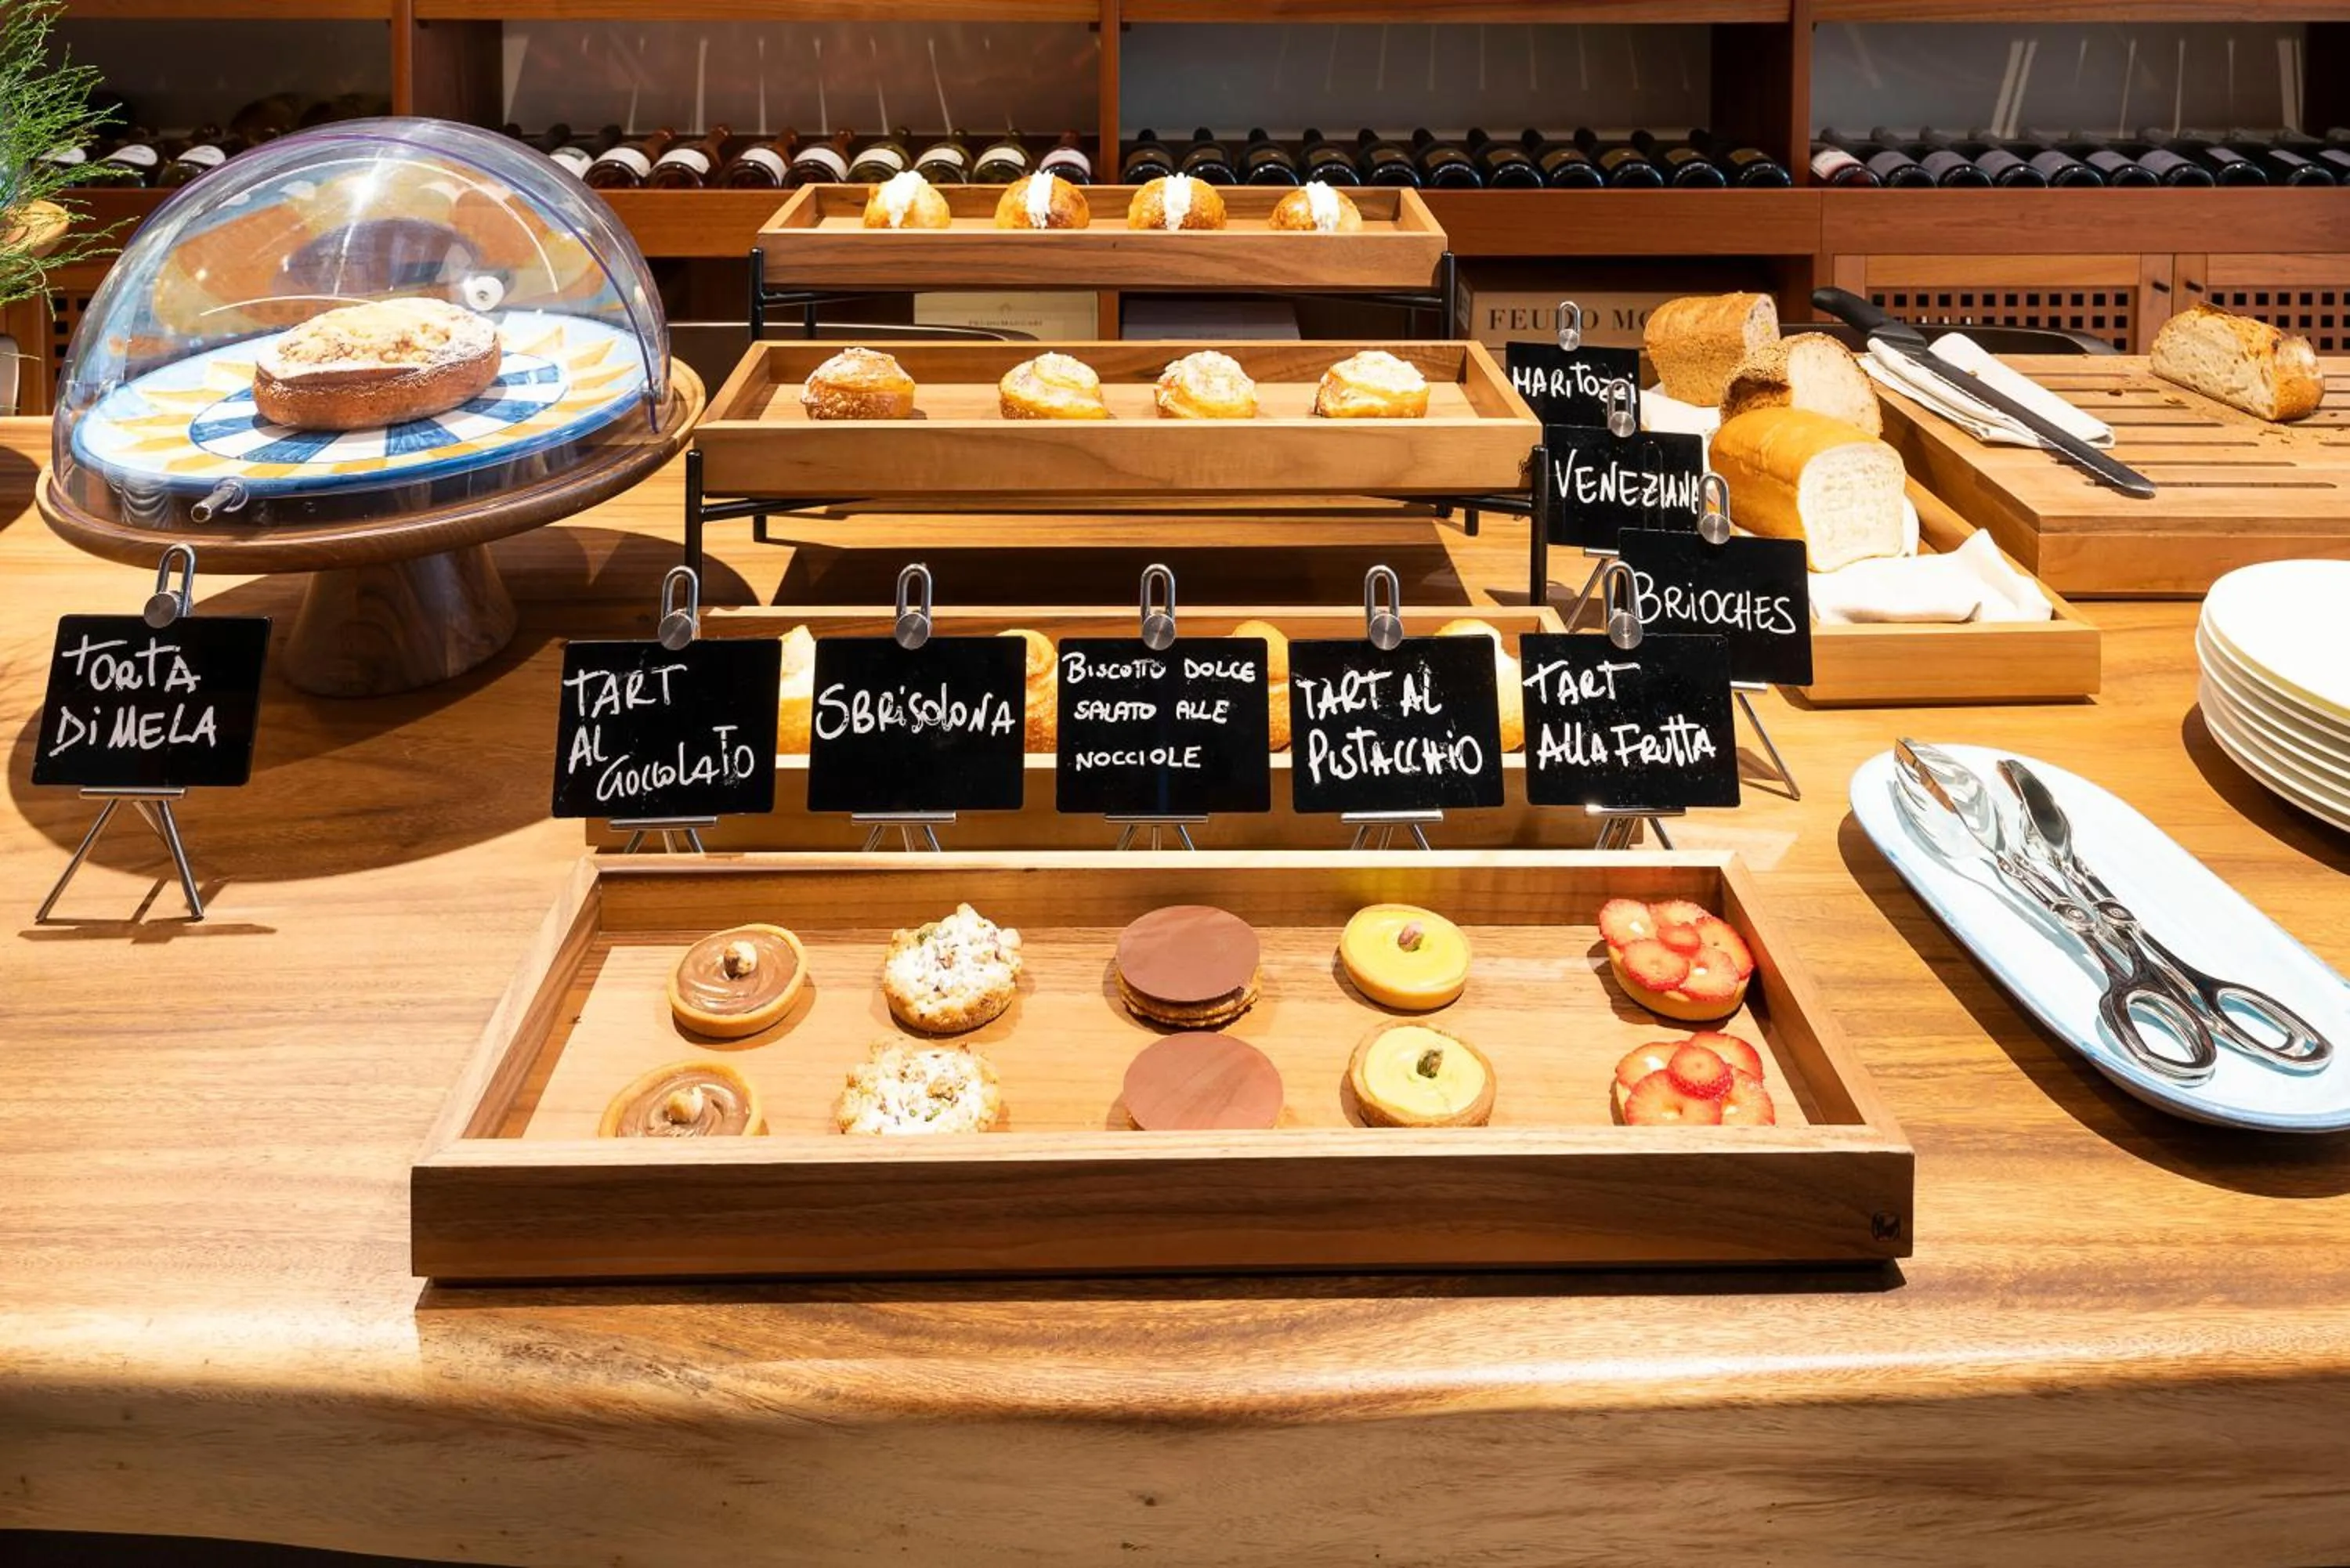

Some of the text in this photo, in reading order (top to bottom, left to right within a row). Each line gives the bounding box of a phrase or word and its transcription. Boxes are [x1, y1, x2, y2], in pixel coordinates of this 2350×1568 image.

[1490, 309, 1599, 331] FEUDO
[62, 634, 201, 692] TORTA
[1061, 652, 1255, 684] BISCOTTO DOLCE
[1523, 660, 1641, 705] TART
[563, 664, 688, 718] TART
[1074, 699, 1230, 724] SALATO ALLE
[1296, 667, 1442, 721] TART AL
[108, 703, 216, 750] MELA
[568, 724, 608, 775] AL
[1076, 746, 1202, 771] NOCCIOLE
